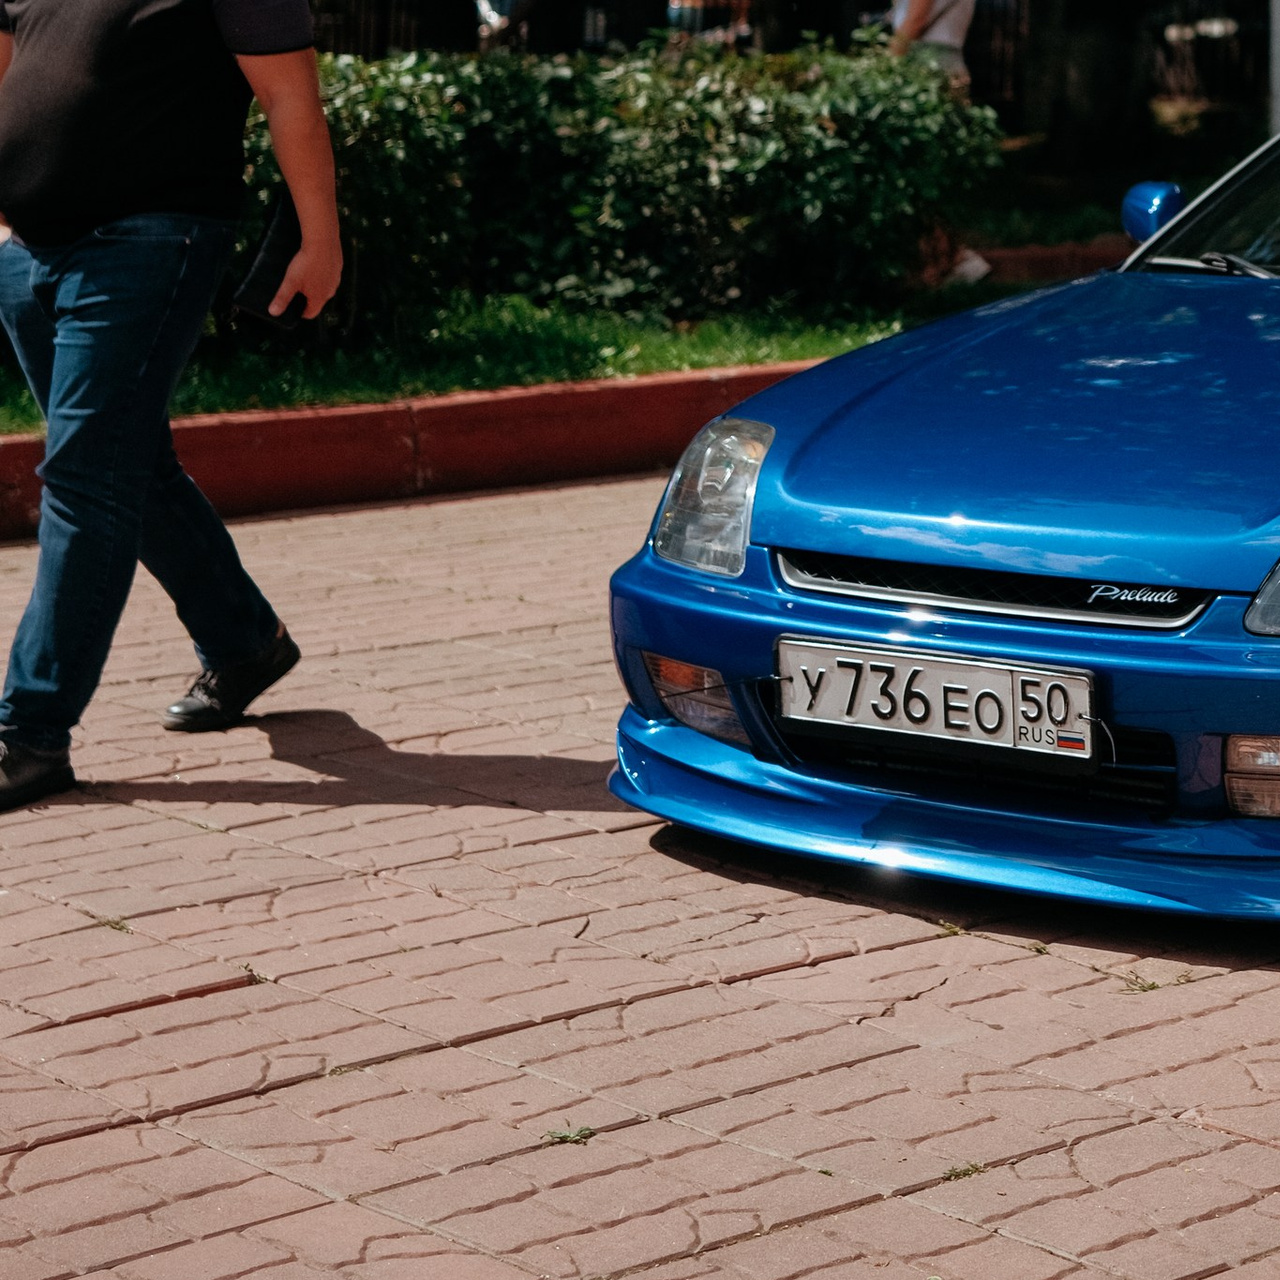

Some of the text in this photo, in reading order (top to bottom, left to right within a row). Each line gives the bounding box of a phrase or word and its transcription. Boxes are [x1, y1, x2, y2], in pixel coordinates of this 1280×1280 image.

[1087, 584, 1179, 604] Prelude
[1019, 675, 1070, 726] 50
[1018, 725, 1056, 746] RUS
